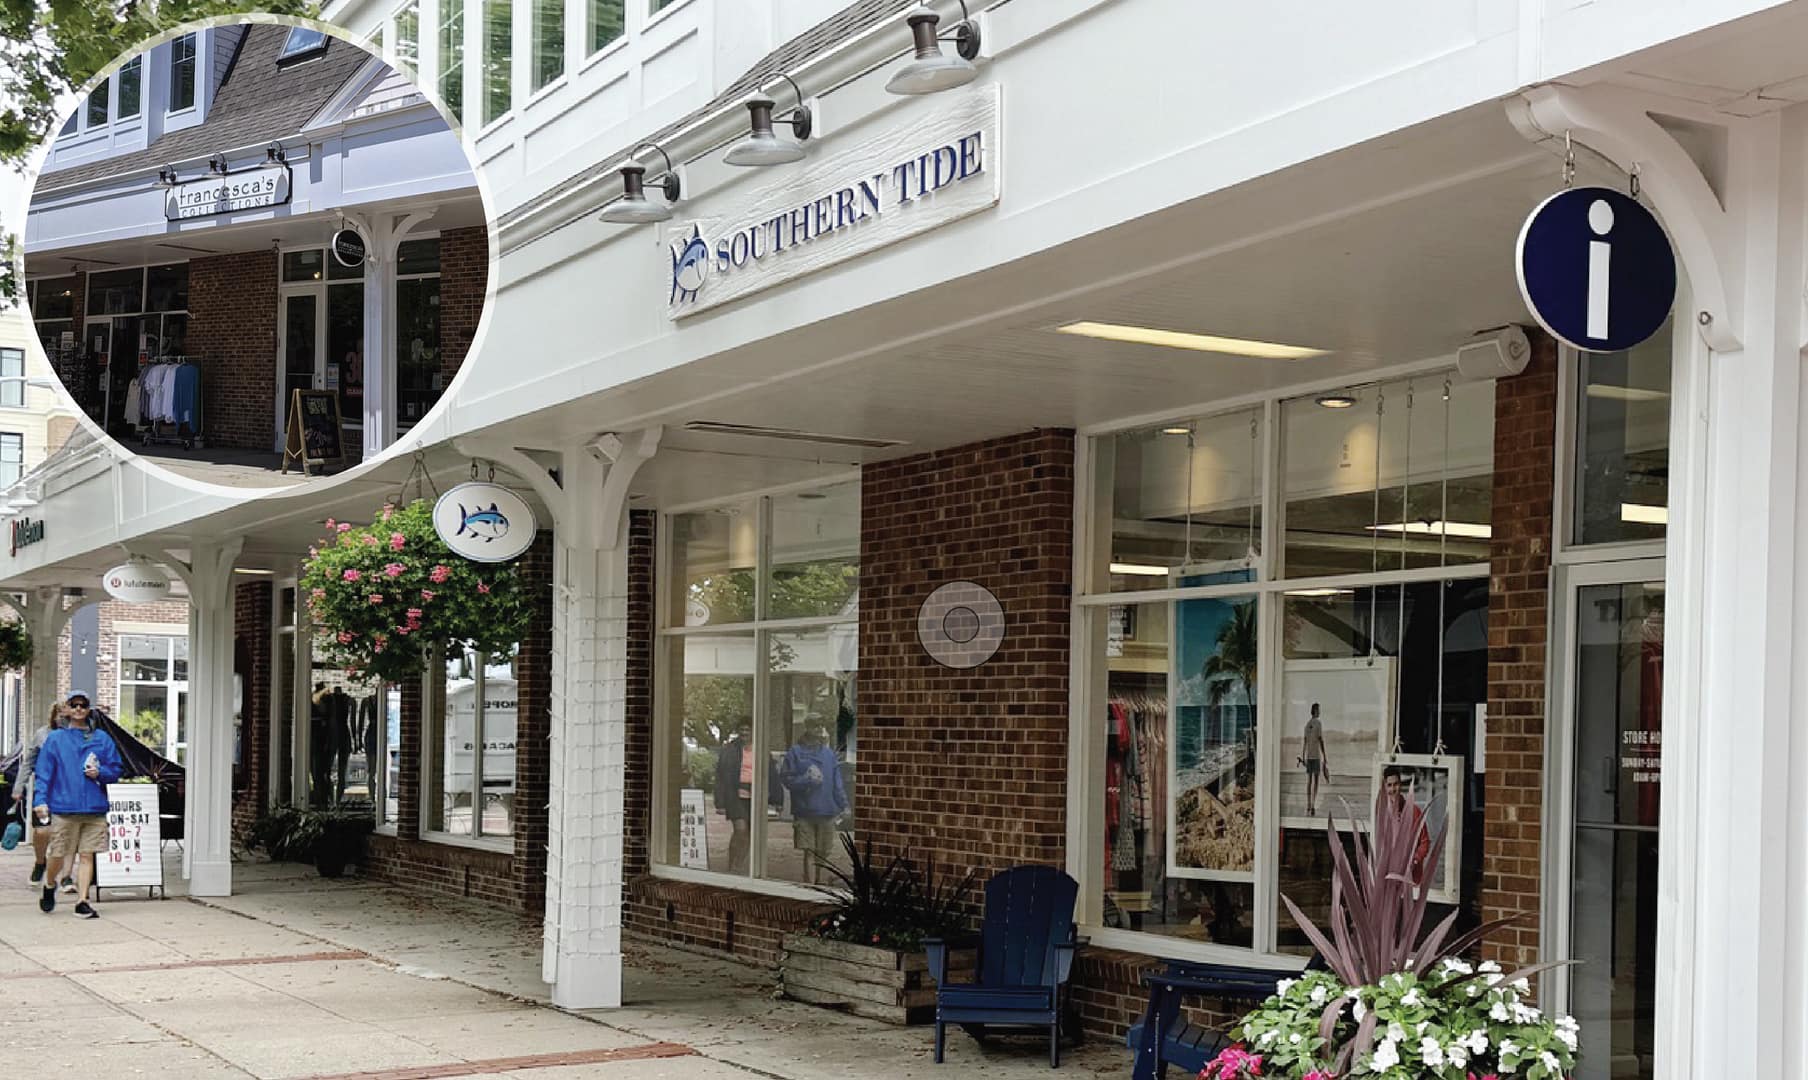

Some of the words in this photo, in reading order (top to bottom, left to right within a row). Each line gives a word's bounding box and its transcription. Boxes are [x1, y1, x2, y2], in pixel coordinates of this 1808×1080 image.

[180, 176, 274, 206] francesca's
[716, 174, 884, 273] SOUTHERN
[892, 131, 983, 205] TIDE
[1622, 730, 1648, 744] STORE
[110, 813, 149, 825] ON-SAT
